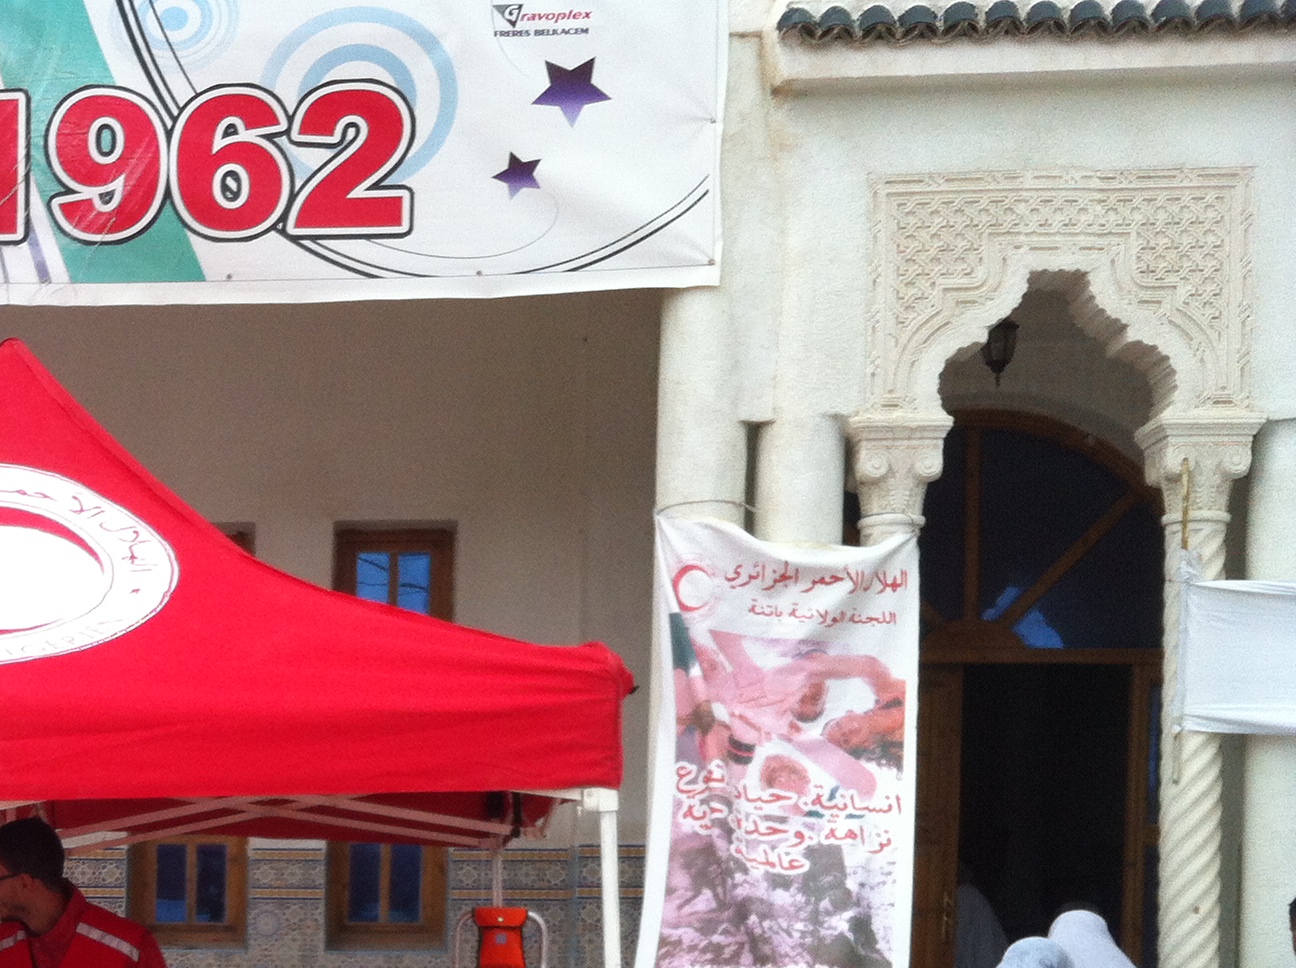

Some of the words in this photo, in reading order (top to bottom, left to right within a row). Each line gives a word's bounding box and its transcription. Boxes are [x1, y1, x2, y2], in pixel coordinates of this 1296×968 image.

[502, 4, 593, 24] Gravoplex
[494, 29, 531, 38] FRERES
[533, 27, 590, 37] BELKACEM
